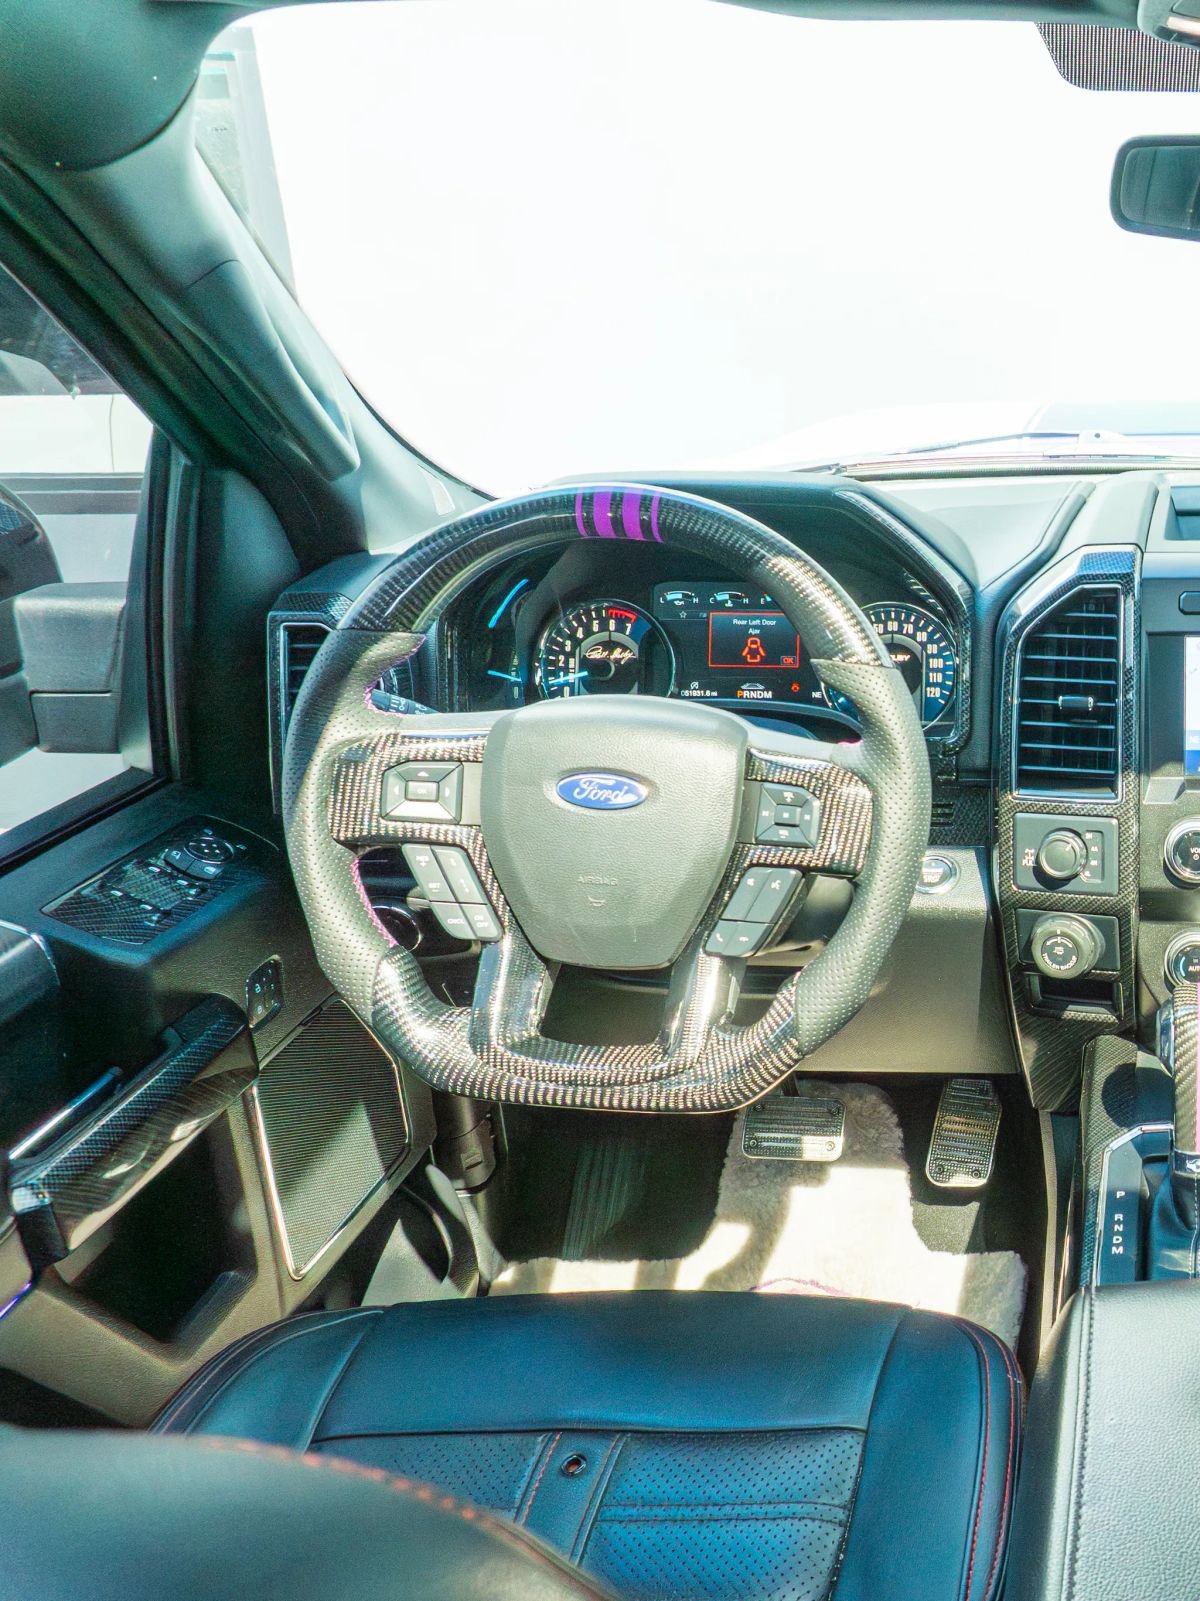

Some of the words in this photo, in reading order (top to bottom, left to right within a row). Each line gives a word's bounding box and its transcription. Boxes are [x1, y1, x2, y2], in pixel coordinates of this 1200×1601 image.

[592, 620, 599, 632] 5
[608, 620, 616, 631] 6
[625, 623, 632, 636] 7
[887, 621, 899, 632] 60
[902, 623, 914, 635] 70
[576, 627, 584, 639] 4
[565, 640, 571, 652] 3
[558, 655, 565, 667] 2
[929, 658, 944, 669] 100
[928, 672, 943, 683] 110
[812, 691, 823, 699] NE
[926, 686, 941, 698] 120
[572, 777, 639, 805] Ford
[1116, 1191, 1126, 1199] P
[1114, 1224, 1123, 1232] N
[1113, 1236, 1122, 1244] D
[1111, 1246, 1124, 1255] M
